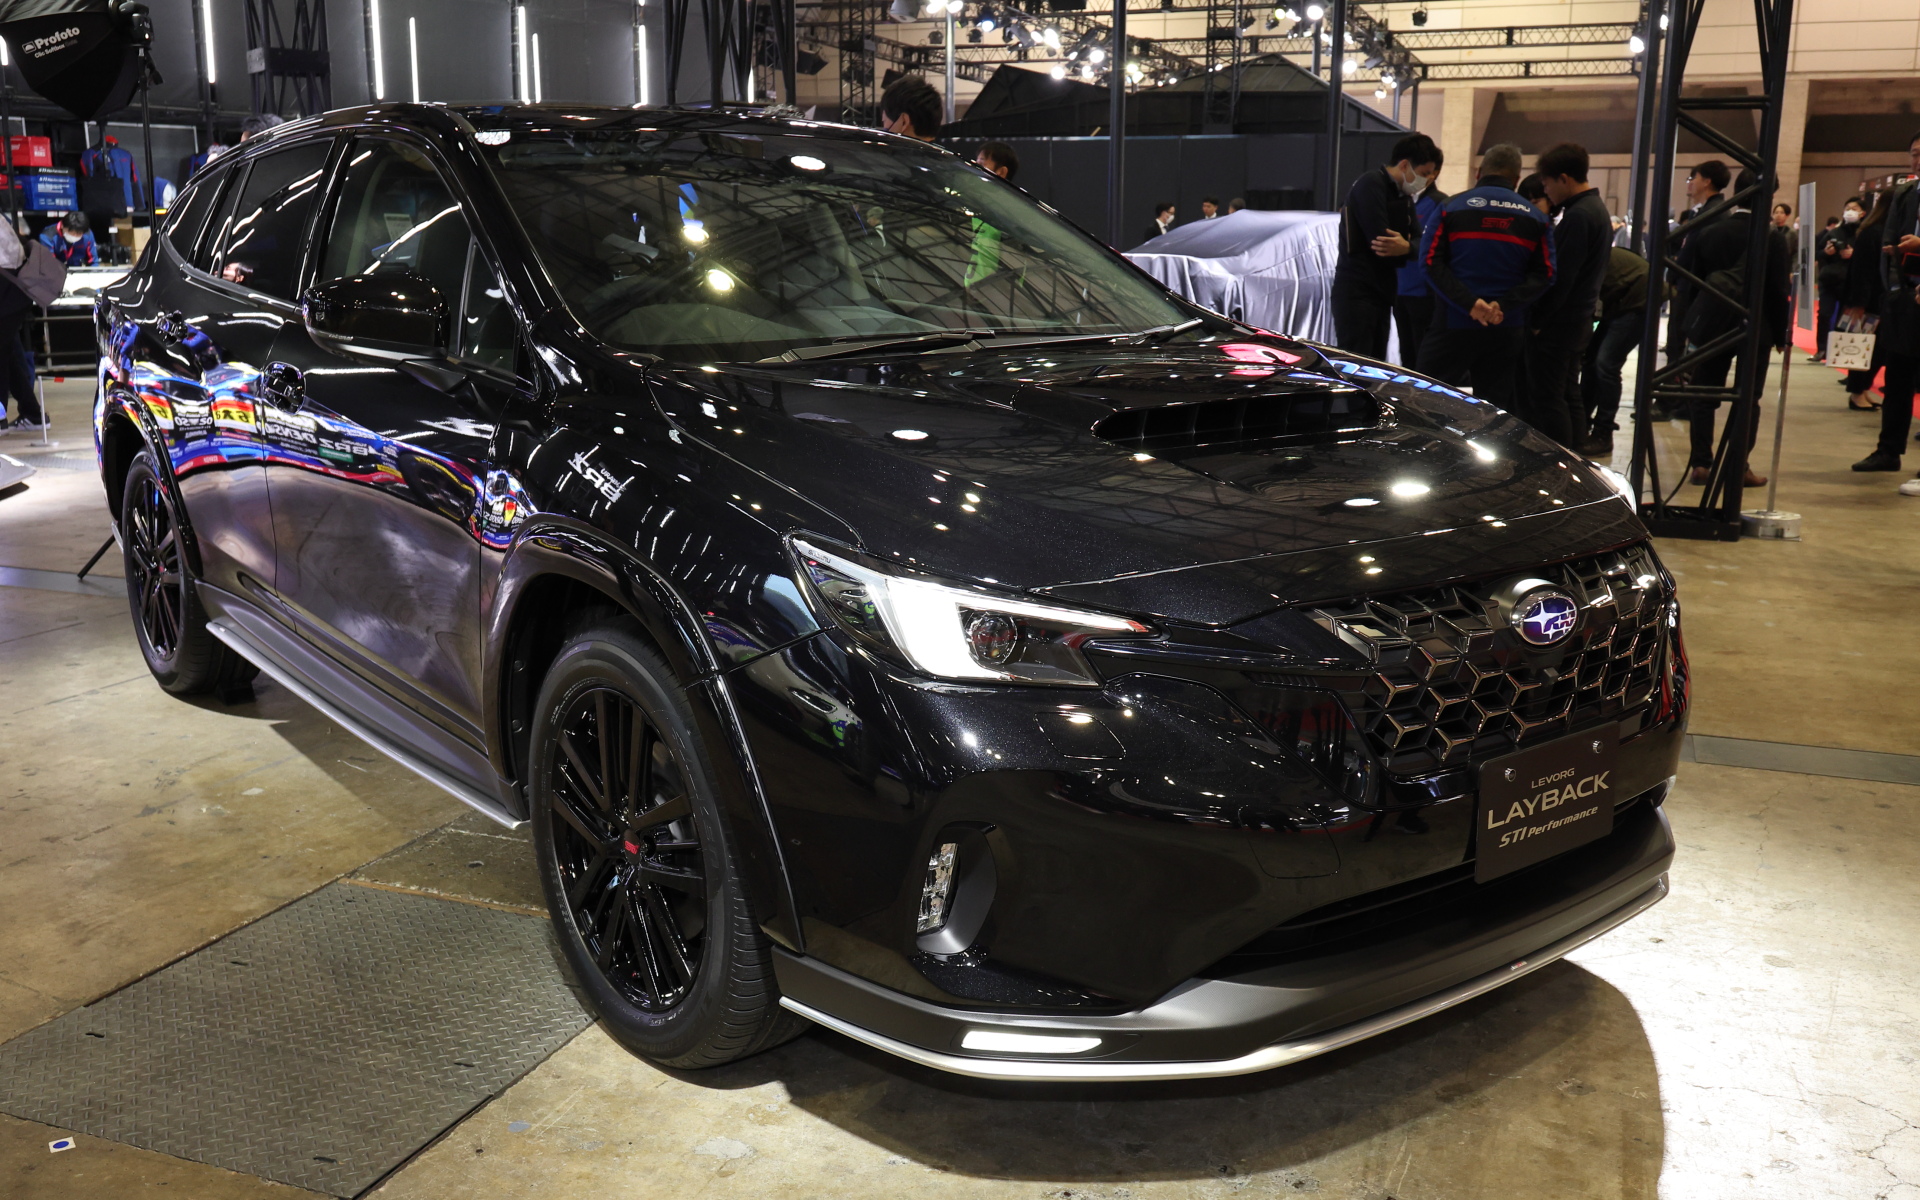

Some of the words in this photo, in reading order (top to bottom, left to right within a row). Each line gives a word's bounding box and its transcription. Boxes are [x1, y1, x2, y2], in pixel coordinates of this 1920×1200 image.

[34, 27, 80, 49] Profoto
[45, 43, 65, 55] Softbox
[1489, 199, 1531, 213] SUBARU
[1531, 768, 1575, 789] LEVORG
[1487, 770, 1610, 830] LAYBACK
[1498, 826, 1528, 848] STI
[1527, 806, 1598, 838] Performance
